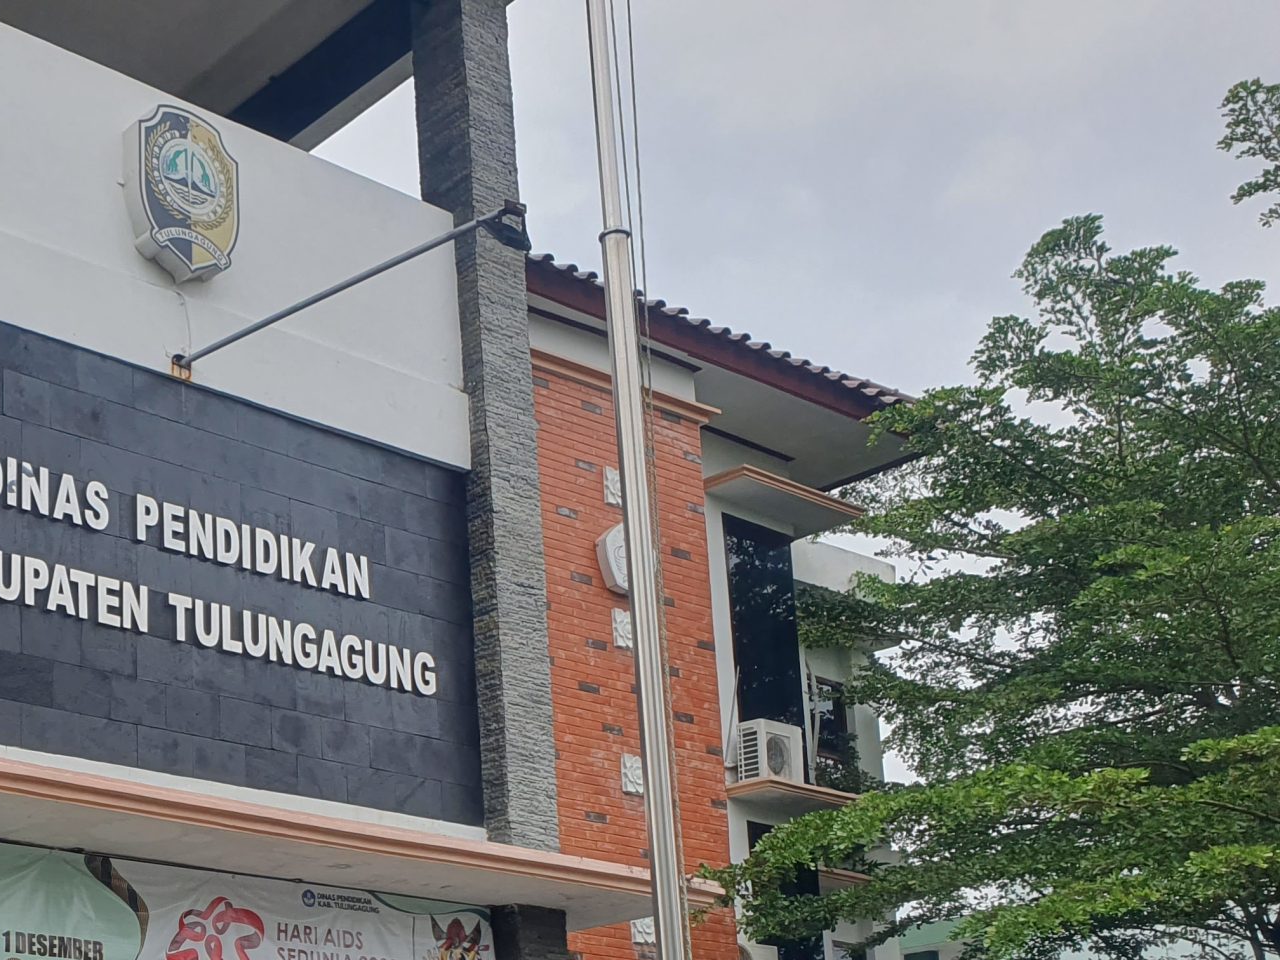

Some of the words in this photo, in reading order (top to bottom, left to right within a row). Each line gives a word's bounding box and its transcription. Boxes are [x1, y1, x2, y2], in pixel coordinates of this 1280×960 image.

[159, 229, 224, 261] TULUNGAGUNG
[136, 493, 370, 600] PENDIDIKAN
[168, 592, 437, 696] TULUNGAGUNG
[317, 893, 335, 901] DINAS
[336, 894, 372, 905] PENDIDIKAN
[334, 902, 380, 914] TULUNGAGUNG
[1, 930, 11, 953] 1
[276, 922, 318, 945] HARI
[323, 928, 364, 950] AIDS
